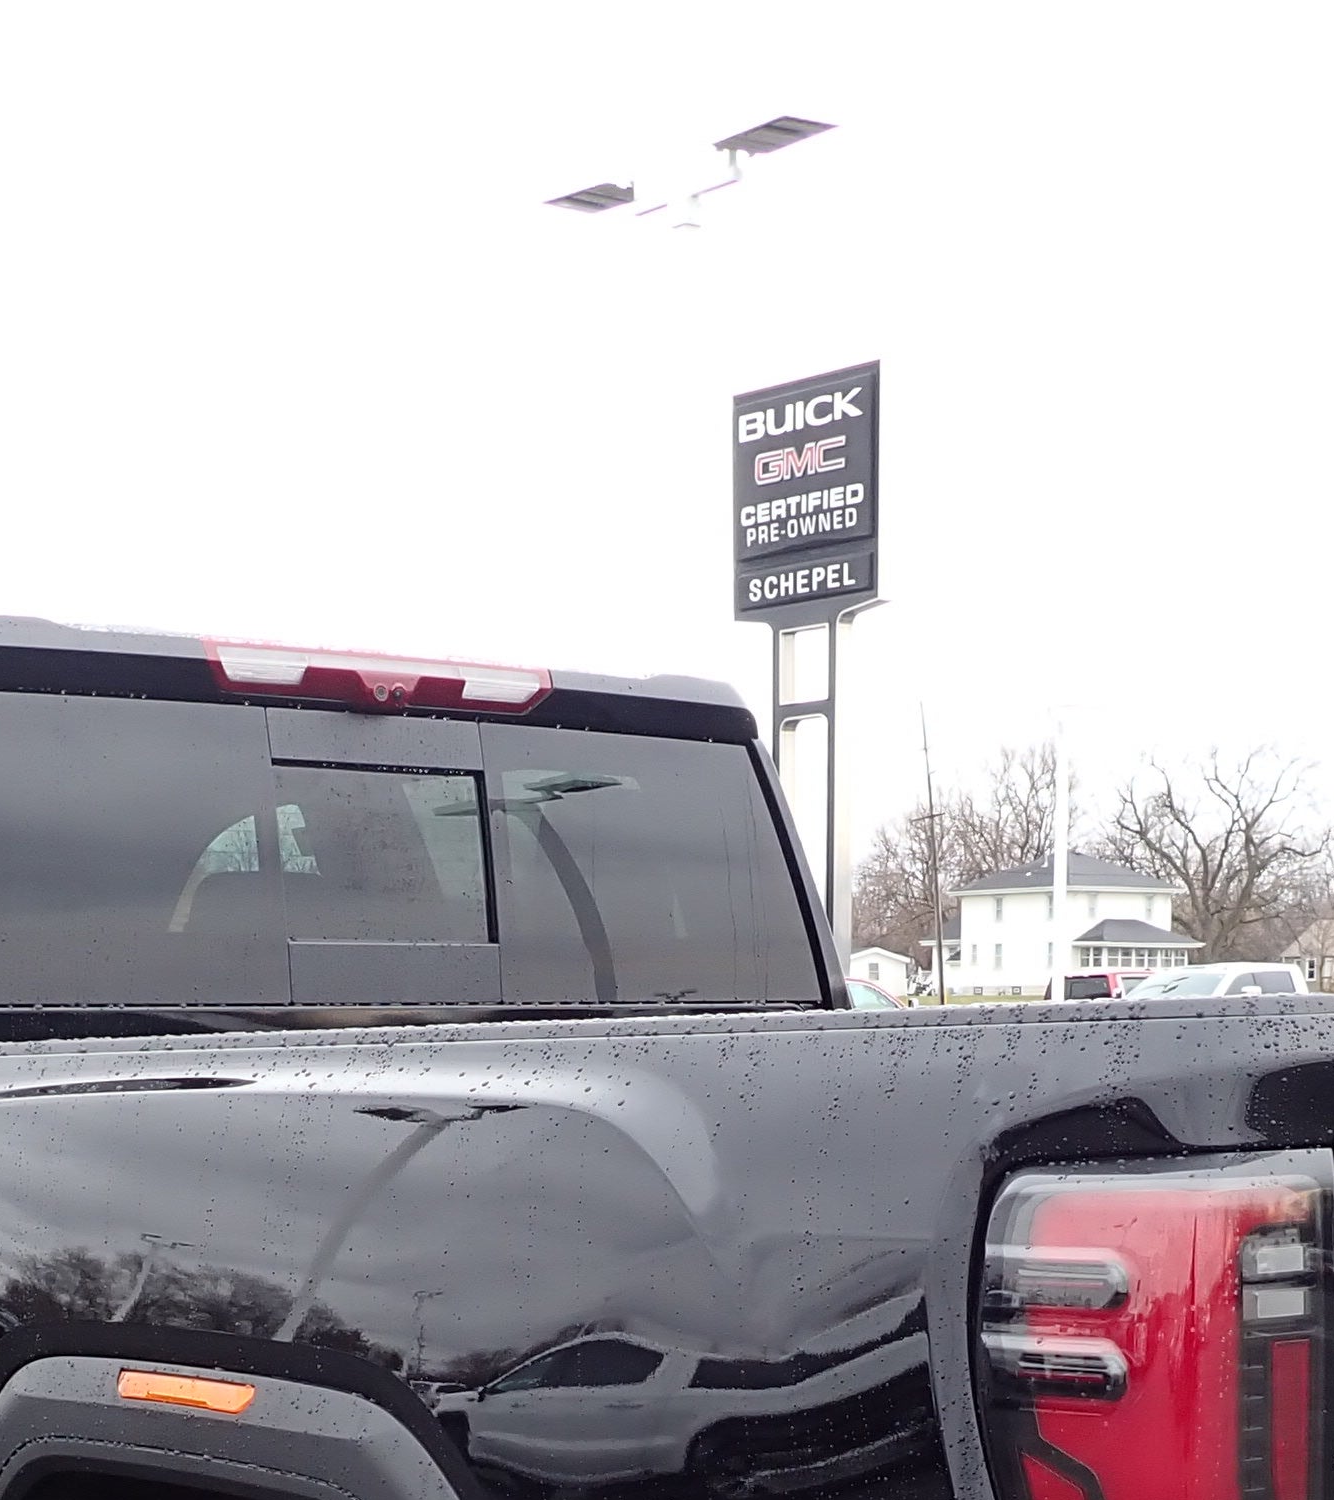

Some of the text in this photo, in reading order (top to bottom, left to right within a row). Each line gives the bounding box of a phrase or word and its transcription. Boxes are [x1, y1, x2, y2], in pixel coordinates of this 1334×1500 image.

[738, 387, 863, 443] BUICK
[755, 435, 846, 485] GMC
[740, 483, 864, 527] CERTIFIED
[746, 507, 857, 547] PRE-OWNED
[749, 563, 855, 601] SCHEPEL
